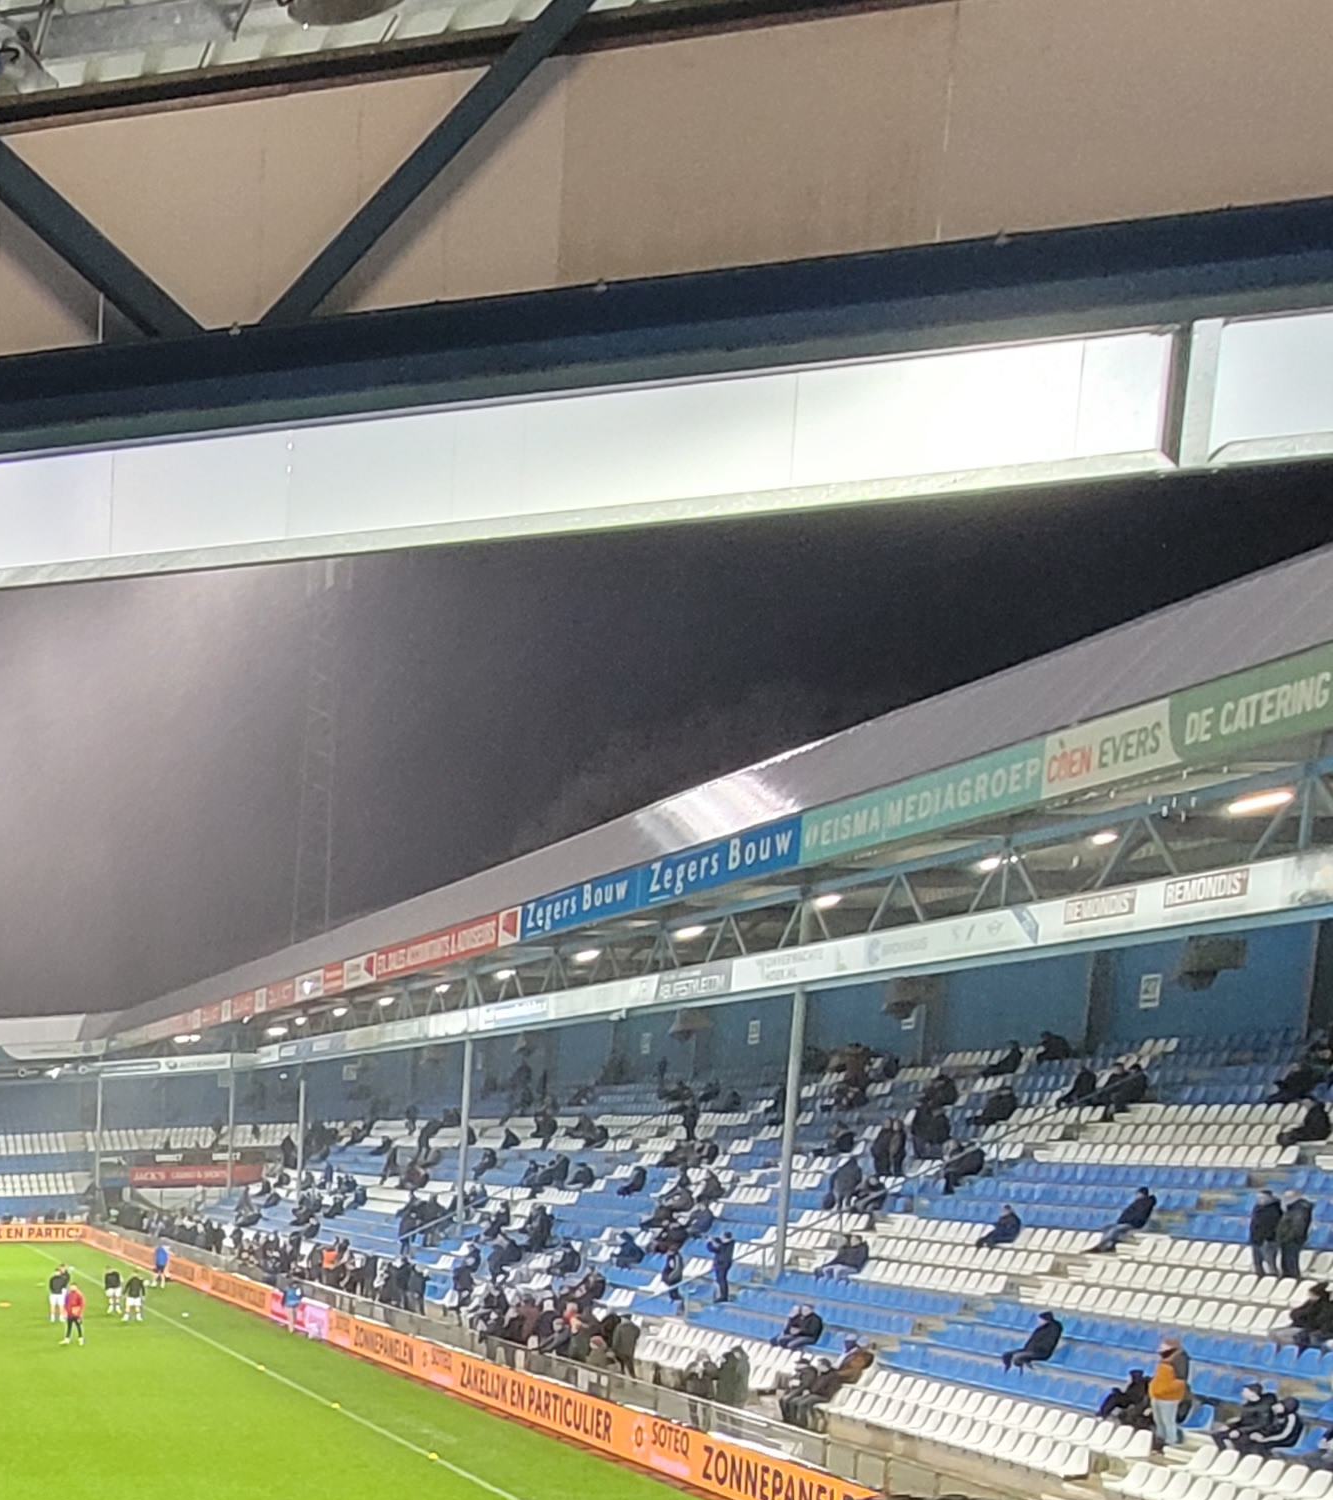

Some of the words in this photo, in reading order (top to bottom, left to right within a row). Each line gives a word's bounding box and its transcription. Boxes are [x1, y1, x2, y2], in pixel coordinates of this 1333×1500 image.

[1184, 707, 1214, 745] DE
[1219, 671, 1331, 735] CATERING
[1047, 742, 1093, 784] COEN
[1098, 721, 1163, 770] EVERS
[820, 806, 881, 846] EISMA
[886, 757, 1042, 827] MEDIAGROEP
[649, 854, 719, 895] Zegers
[727, 829, 794, 871] Bouw
[1165, 876, 1243, 905] REMONDIS
[526, 893, 576, 931] Zegers
[581, 878, 629, 911] Bouw
[1064, 892, 1132, 921] REMONDIS
[6, 1227, 25, 1239] EN
[460, 1361, 508, 1404] ZAKELIJK
[511, 1379, 525, 1411] EN
[527, 1383, 612, 1444] PARTICULIER
[651, 1421, 691, 1460] SOTEQ
